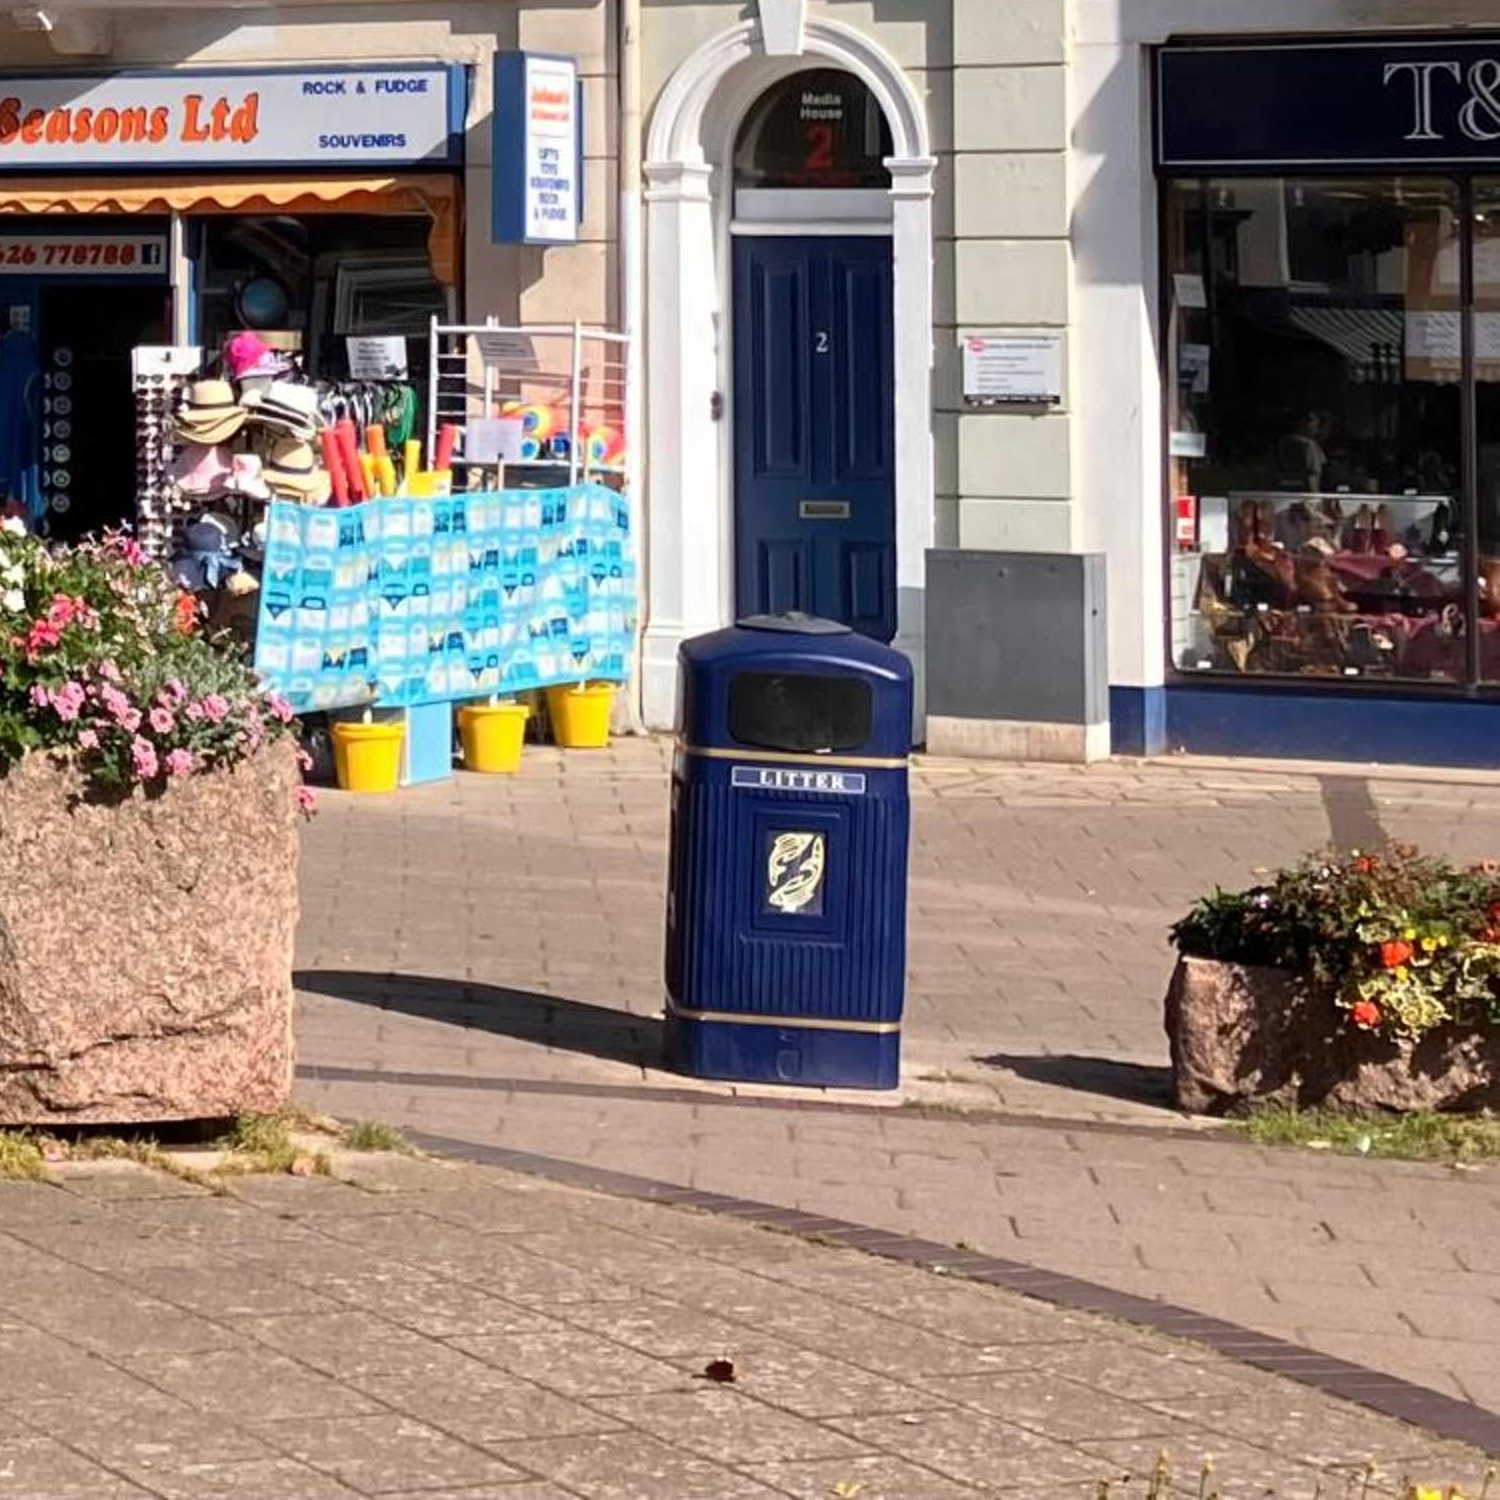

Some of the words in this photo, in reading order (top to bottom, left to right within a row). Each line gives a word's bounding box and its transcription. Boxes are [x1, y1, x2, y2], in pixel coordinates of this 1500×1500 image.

[302, 81, 346, 96] ROCK
[355, 81, 365, 94] &
[375, 79, 428, 94] FUDGE
[801, 91, 842, 105] Media
[180, 92, 261, 144] Ltd
[800, 108, 843, 119] House
[318, 133, 407, 150] SOUVENIRS
[804, 123, 834, 168] 2
[815, 332, 829, 353] 2
[759, 770, 845, 789] LITTER
